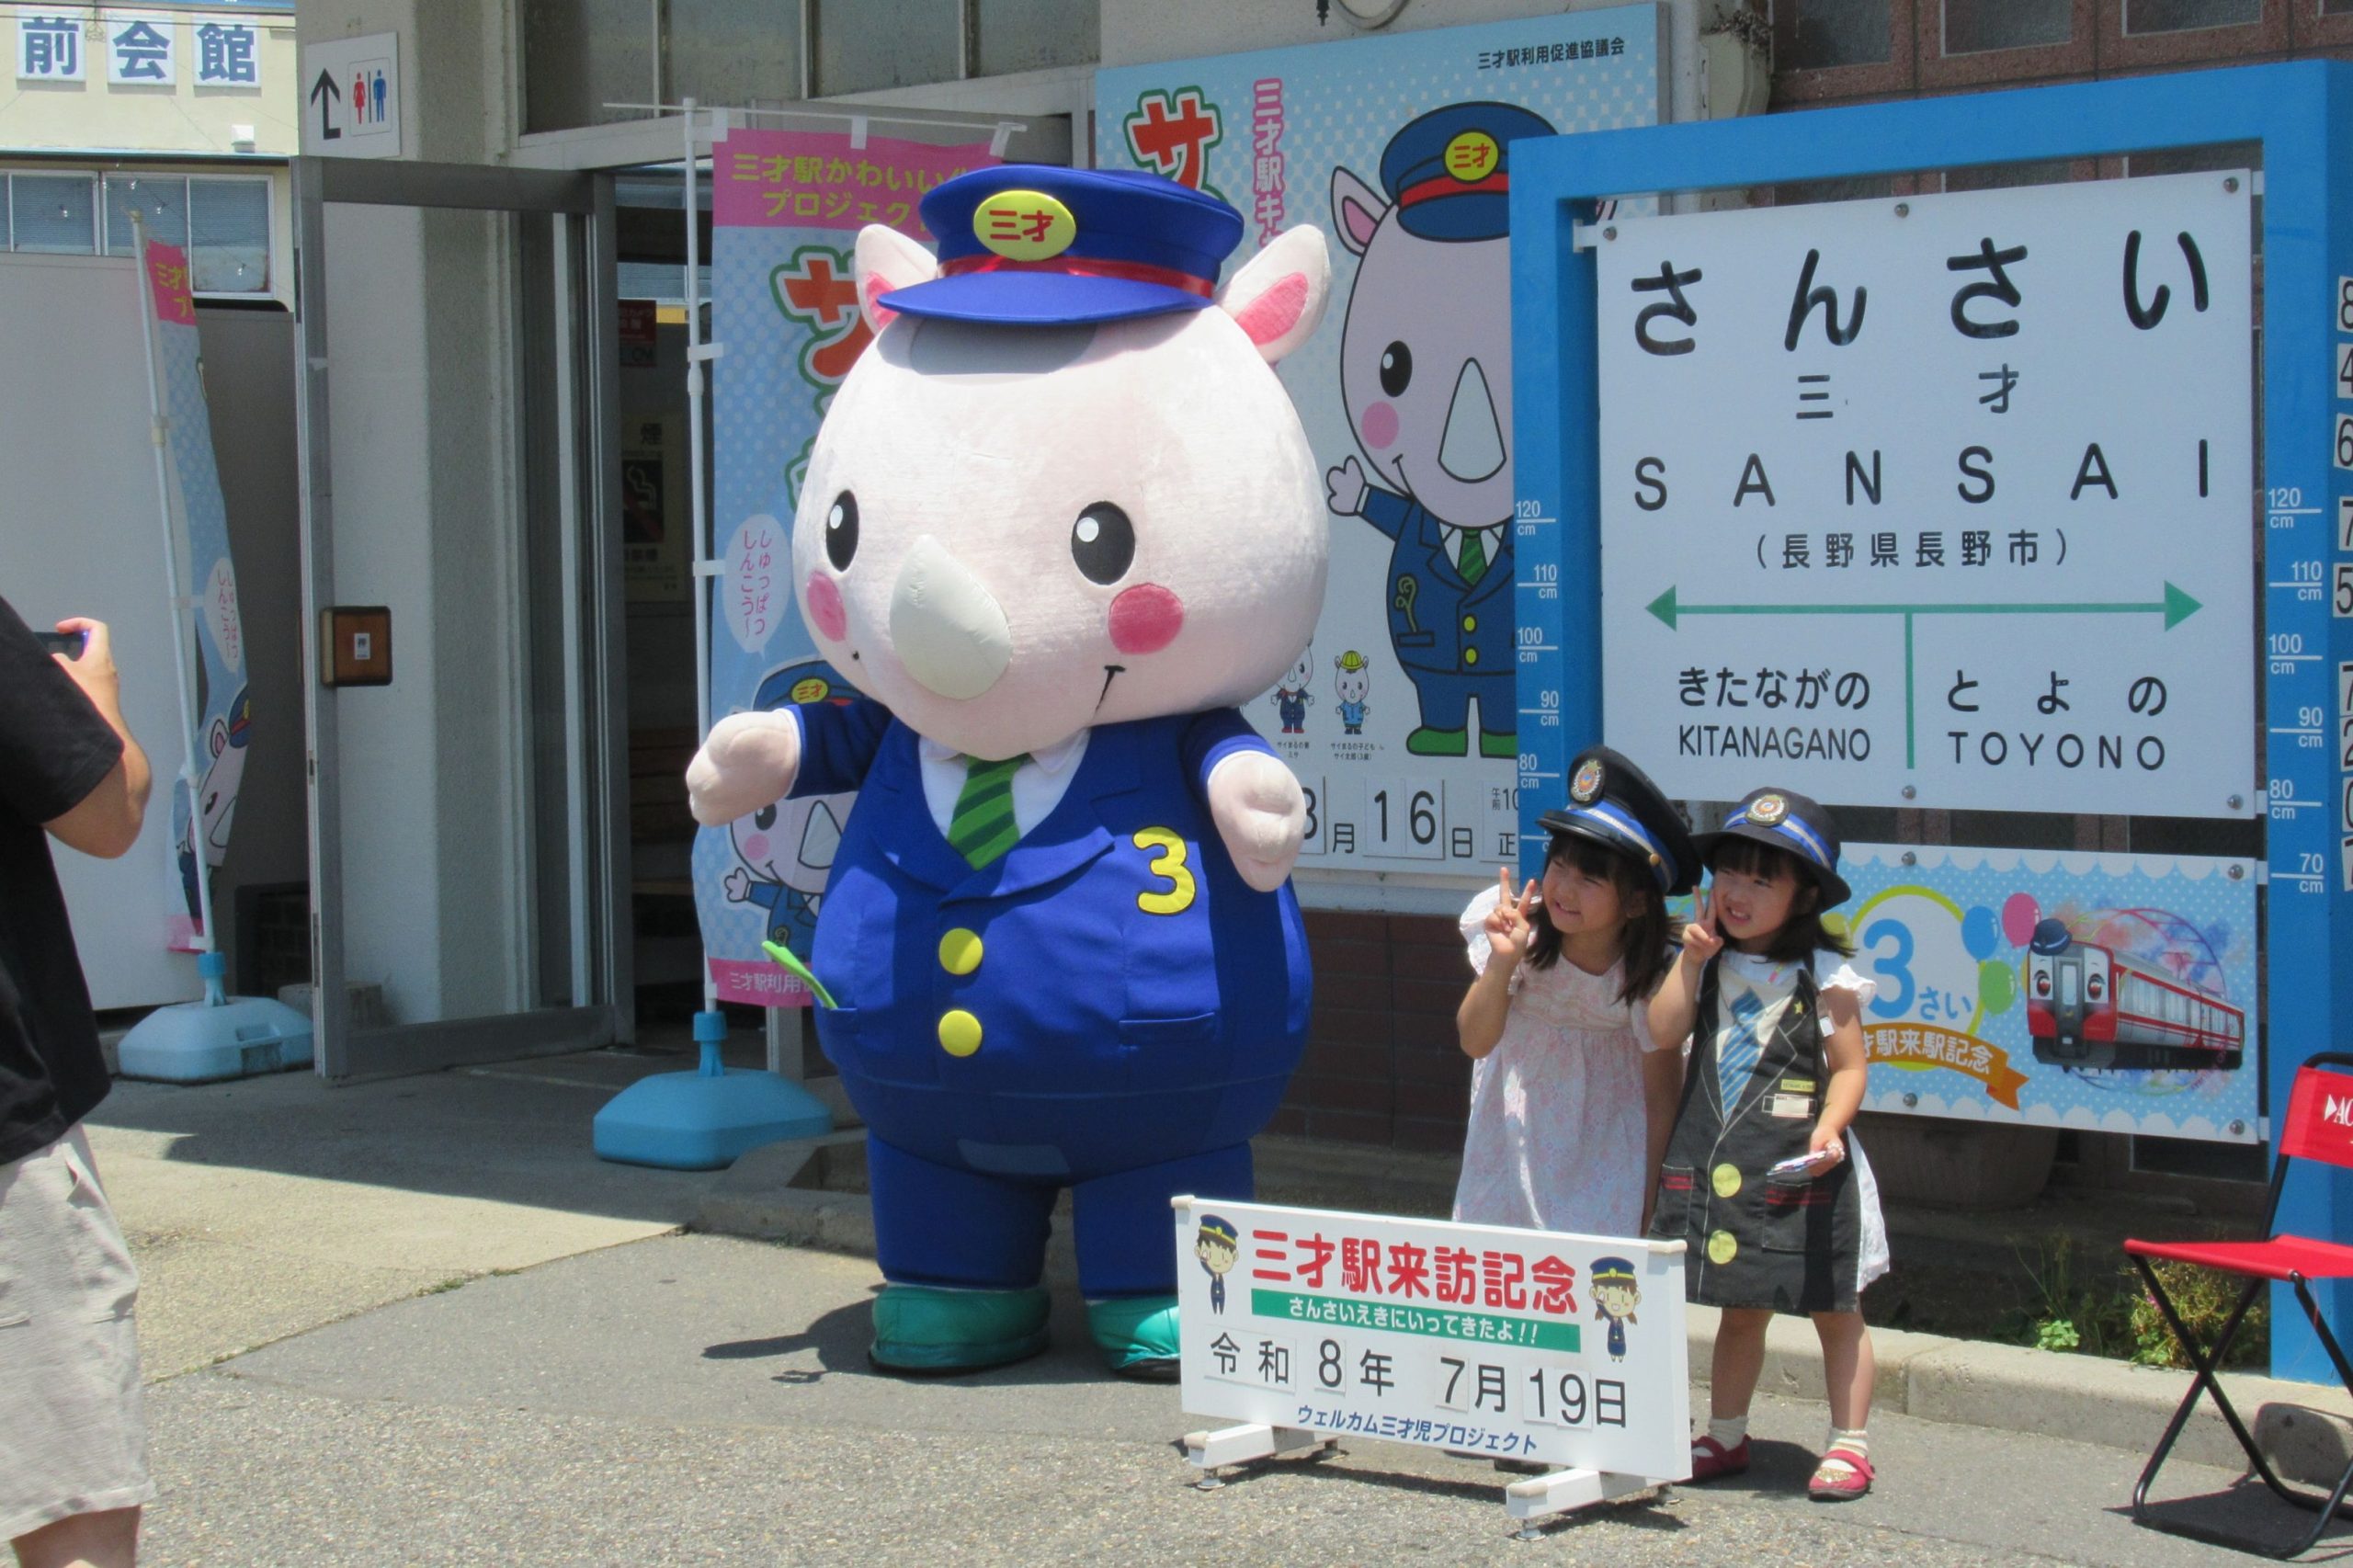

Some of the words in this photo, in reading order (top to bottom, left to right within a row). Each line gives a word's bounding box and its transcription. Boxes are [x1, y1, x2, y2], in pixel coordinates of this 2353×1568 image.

[22, 16, 256, 83] 前会館
[1478, 37, 1624, 70] 三才駅利用促進協議会
[1453, 143, 1490, 169] 三才
[733, 153, 968, 193] 三才駅かわいい
[763, 188, 926, 232] プロジェク
[989, 210, 1054, 242] 三才
[1631, 229, 2209, 356] さんさい
[1796, 363, 2020, 420] 三才
[1634, 438, 2209, 511] SANSAI
[2268, 488, 2301, 507] 120
[1516, 501, 1540, 517] 120
[1518, 525, 1536, 536] cm
[2270, 515, 2294, 528] cm
[1756, 528, 2068, 569] (長野県長野市)
[1533, 564, 1557, 581] 110
[2291, 562, 2323, 581] 110
[755, 529, 772, 635] しゅっぱつ
[1539, 587, 1557, 599] cm
[2298, 586, 2322, 600] cm
[1518, 628, 1542, 644] 100
[2268, 635, 2302, 654] 100
[1519, 652, 1538, 663] cm
[2271, 661, 2294, 675] cm
[796, 683, 823, 700] 三才
[1677, 665, 1870, 710] きたながの
[1947, 670, 2167, 717] とよの
[1540, 691, 1559, 708] 90
[1540, 714, 1559, 726] cm
[2298, 707, 2323, 726] 90
[1678, 724, 1870, 762] KITANAGANO
[2299, 733, 2323, 747] cm
[1948, 731, 2165, 771] TOYONO
[1519, 754, 1537, 770] 80
[1520, 778, 1539, 789] cm
[2269, 779, 2294, 799] 80
[2271, 806, 2296, 820] cm
[1131, 825, 1196, 916] 3
[2300, 853, 2324, 873] 70
[2300, 879, 2324, 893] cm
[1252, 1229, 1577, 1314] 三才駅来訪記念
[1289, 1297, 1539, 1345] さんさいえきにいってきたよ!!
[1298, 1404, 1538, 1456] ウェルカム三才児プロジェクト
